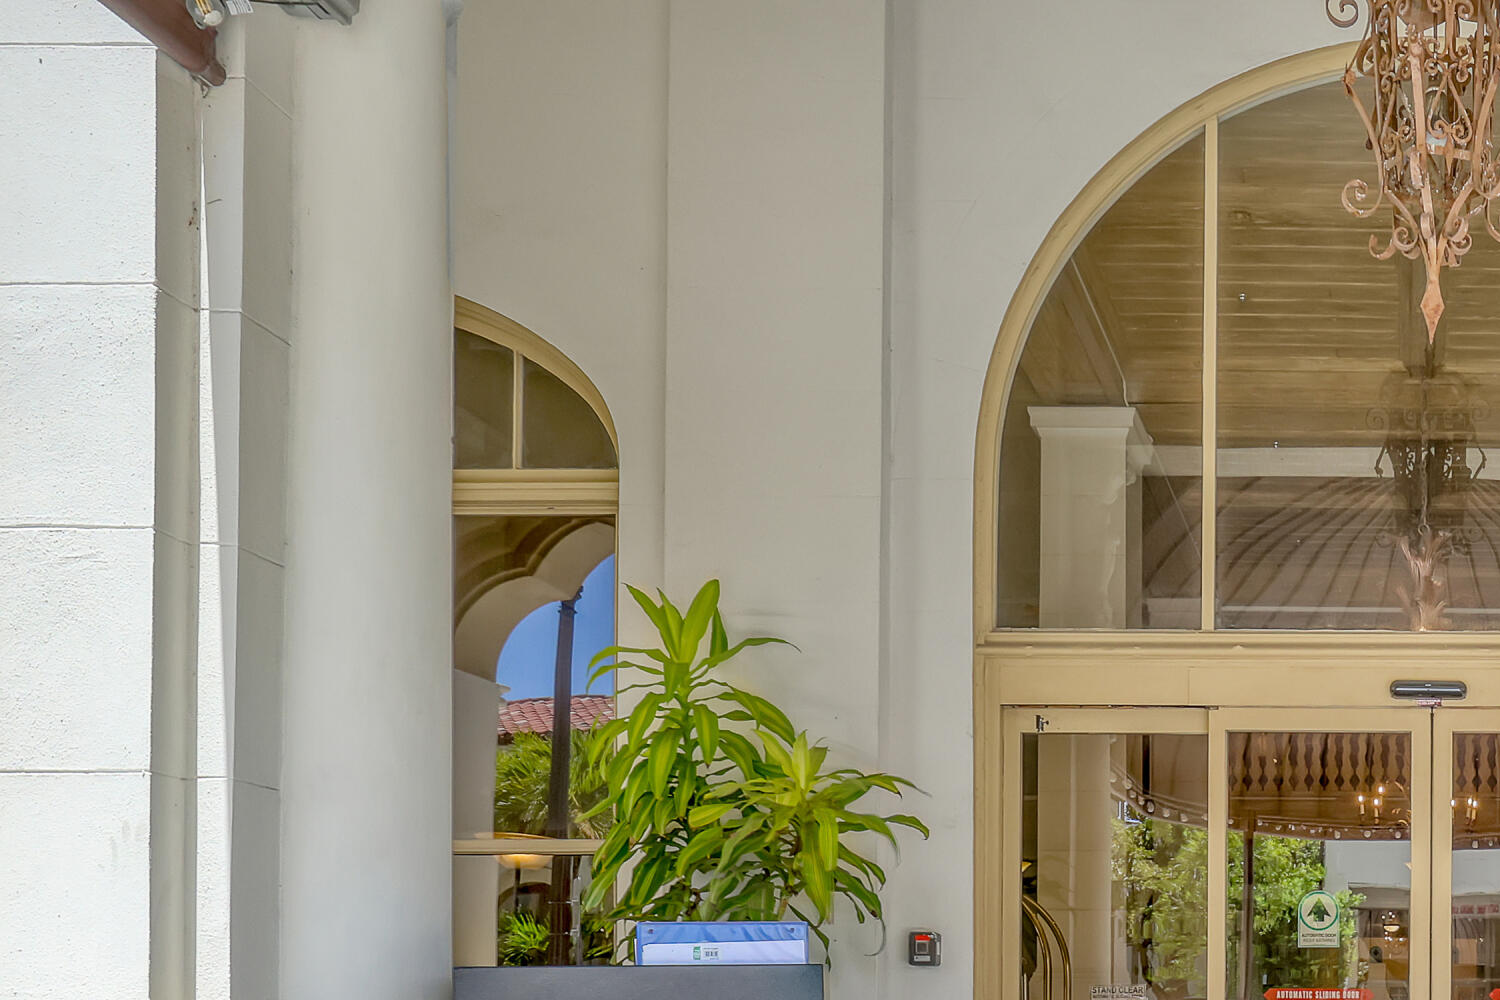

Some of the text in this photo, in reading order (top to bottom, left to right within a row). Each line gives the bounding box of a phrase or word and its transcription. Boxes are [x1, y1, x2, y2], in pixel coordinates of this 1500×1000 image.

[1092, 985, 1144, 994] STAND CLEAR
[1276, 990, 1360, 999] AUTOMATIC SLIDING DOOR
